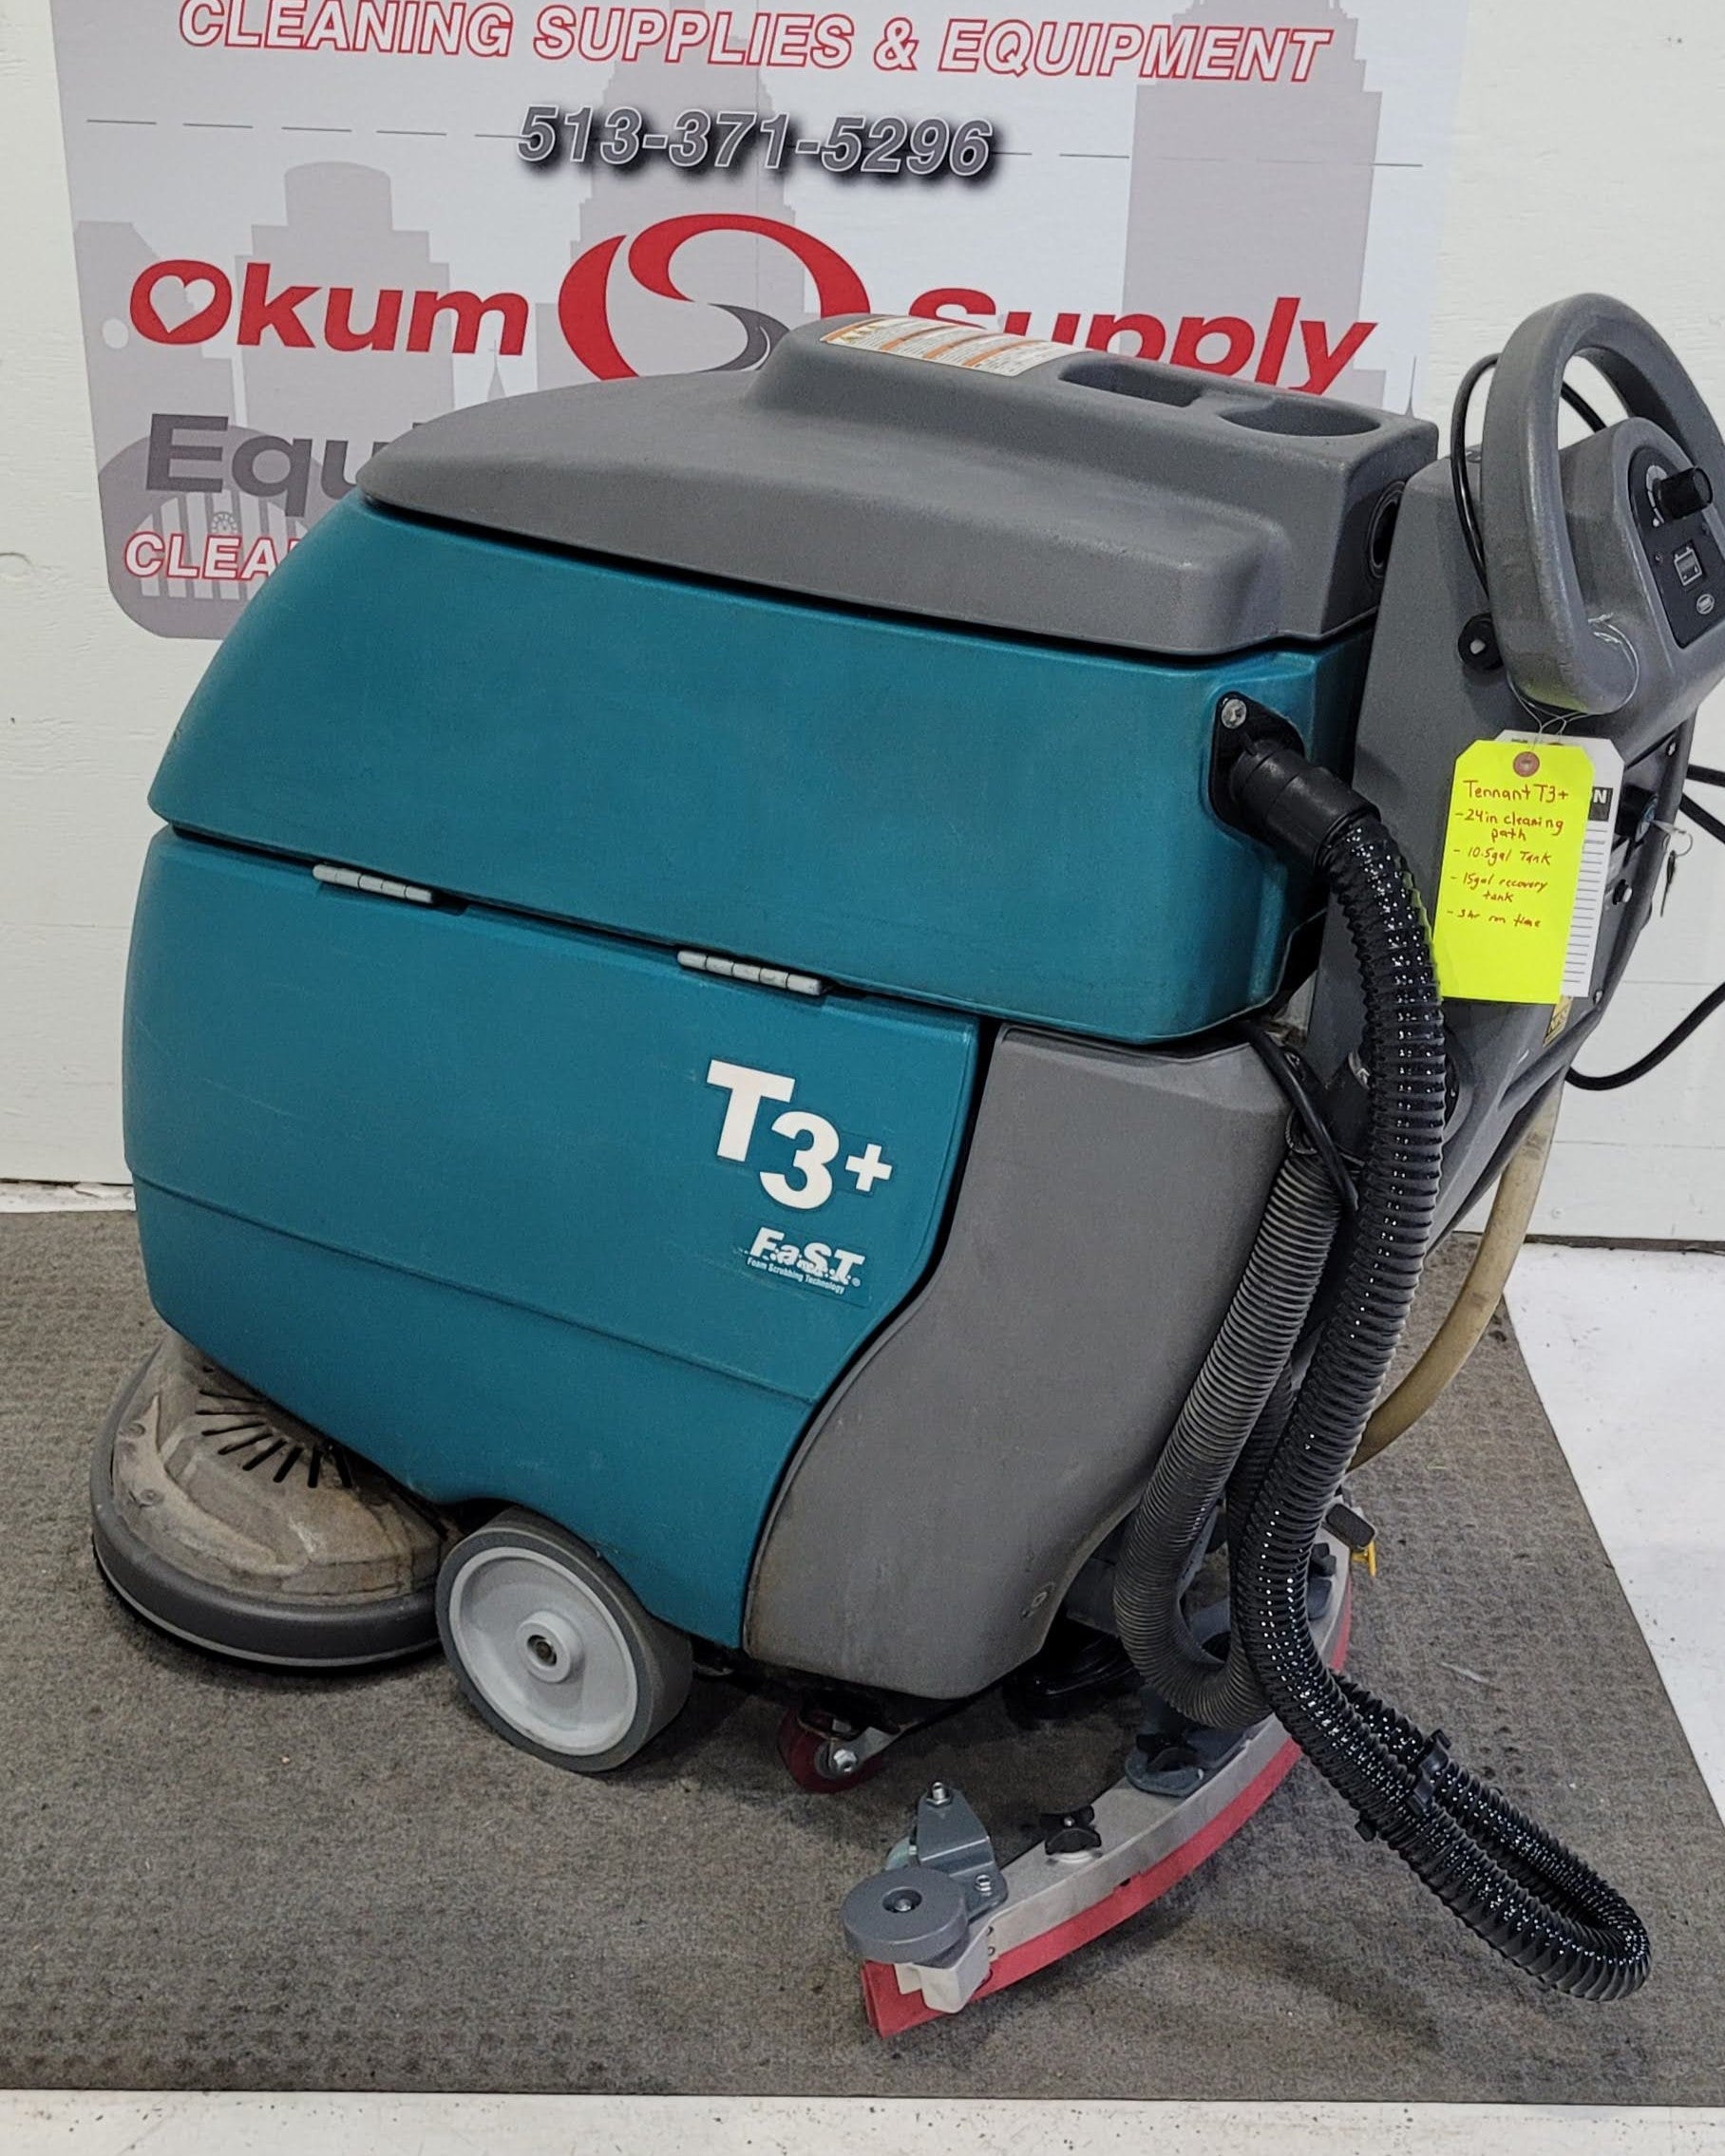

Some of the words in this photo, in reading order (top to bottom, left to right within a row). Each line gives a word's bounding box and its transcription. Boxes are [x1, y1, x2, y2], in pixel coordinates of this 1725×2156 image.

[179, 0, 515, 57] CLEANING
[533, 5, 855, 70] SUPPLIES
[873, 16, 919, 72] &
[938, 18, 1335, 83] EQUIPMENT
[517, 104, 994, 177] 513-371-5296
[129, 258, 530, 357] Okum
[1463, 779, 1531, 801] Tennant
[1533, 784, 1569, 804] T3+
[1490, 828, 1526, 843] path
[1483, 890, 1514, 903] tank
[1498, 879, 1548, 894] recovery
[707, 1059, 893, 1210] T3+
